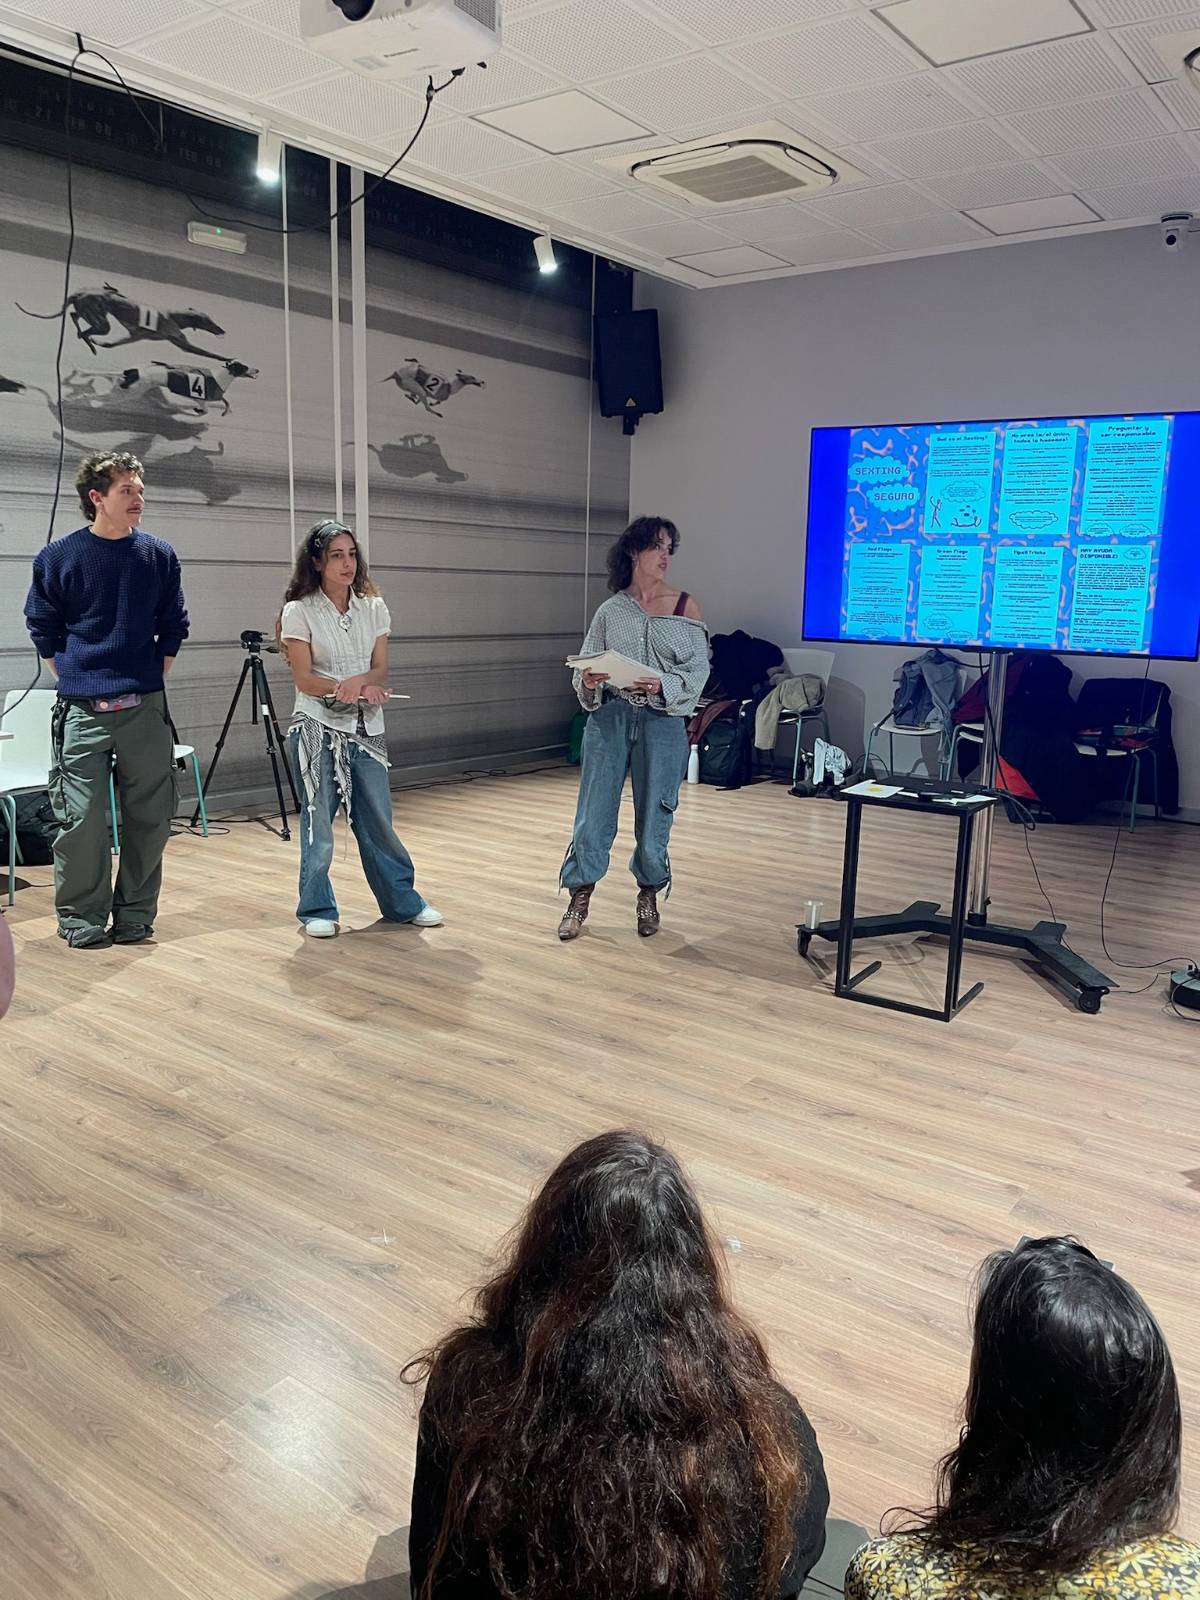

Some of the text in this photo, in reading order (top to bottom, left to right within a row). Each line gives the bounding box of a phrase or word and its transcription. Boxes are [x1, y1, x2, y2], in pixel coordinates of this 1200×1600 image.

[191, 376, 203, 397] 4
[427, 377, 440, 392] 2
[855, 467, 901, 476] SEXTING
[874, 492, 915, 501] SEGURO
